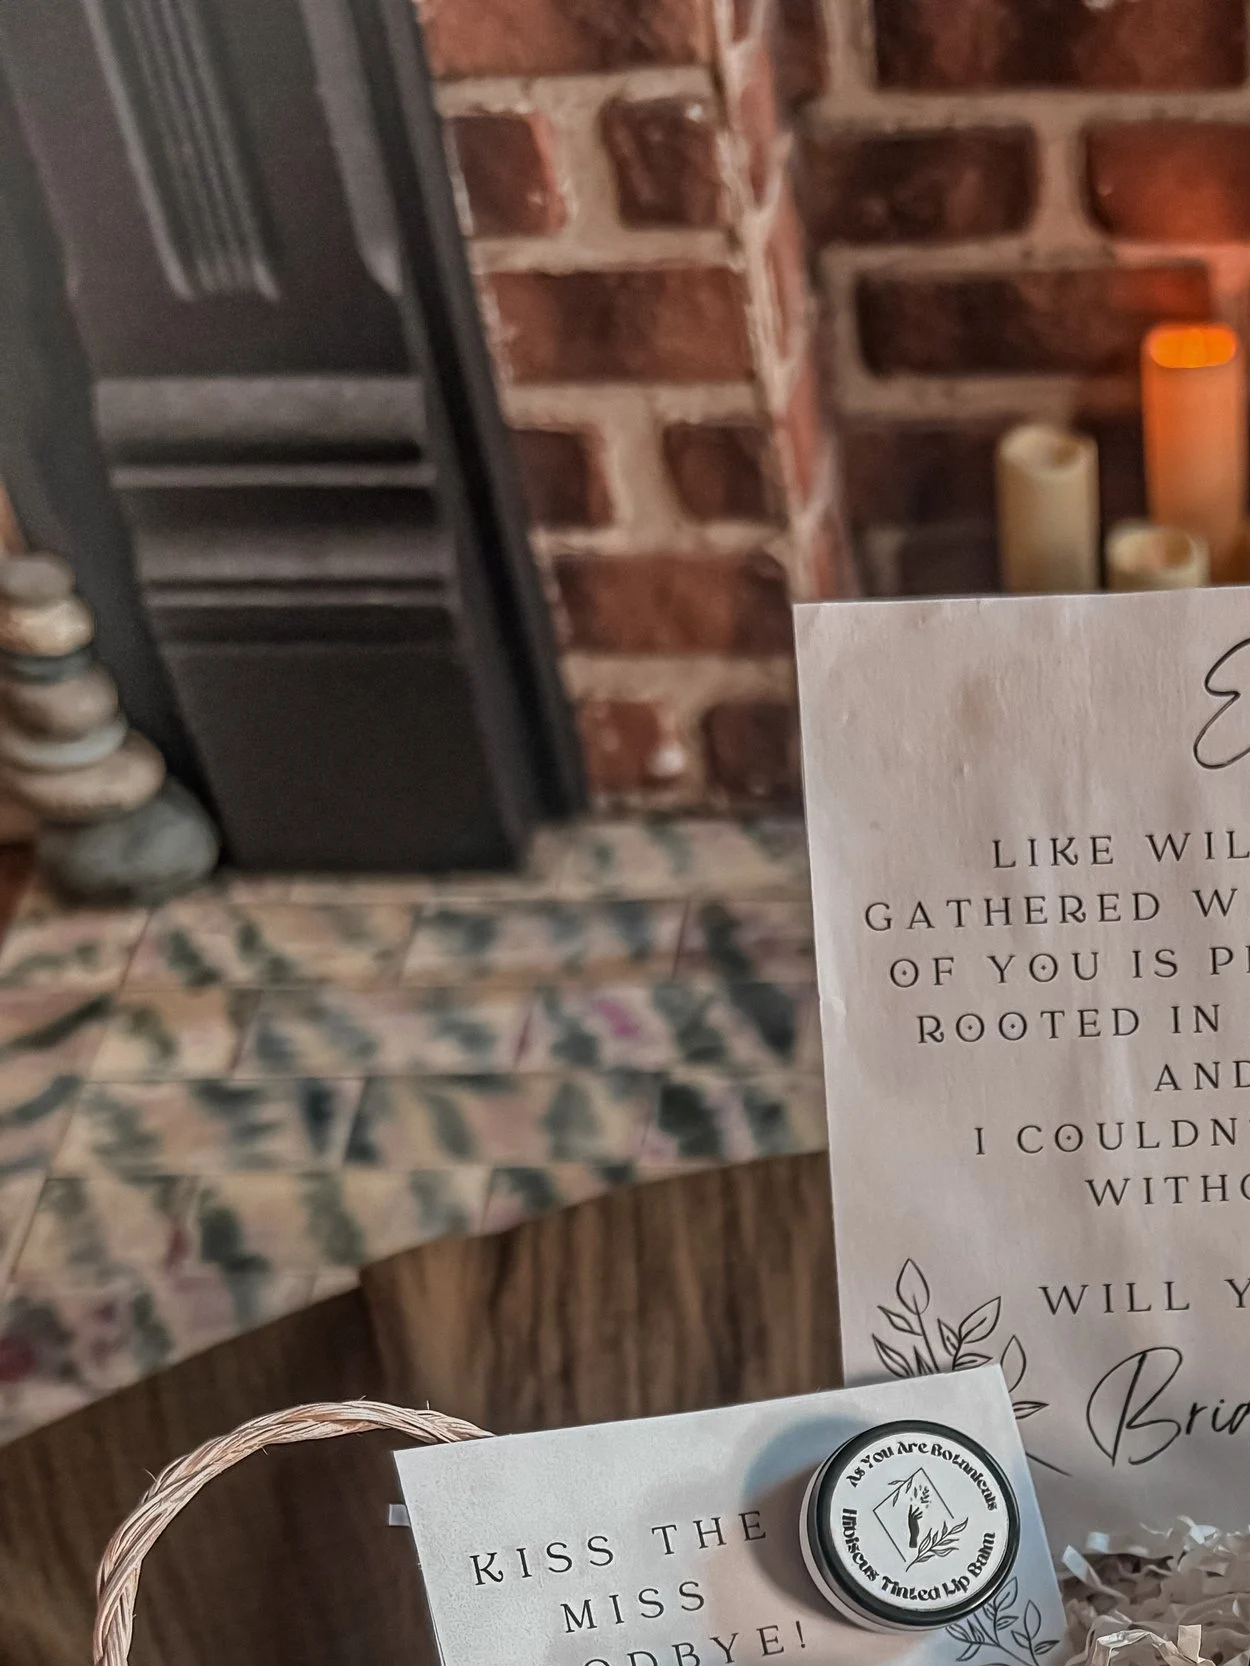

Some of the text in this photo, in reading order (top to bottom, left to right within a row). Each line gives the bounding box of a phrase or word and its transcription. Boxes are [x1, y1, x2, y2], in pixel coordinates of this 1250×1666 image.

[992, 835, 1113, 868] LIKE
[865, 892, 1160, 931] GATHERED
[890, 957, 954, 988] OF
[987, 952, 1098, 983] YOU
[1132, 949, 1177, 978] IS
[917, 1008, 1139, 1043] ROOTED
[1171, 1004, 1220, 1034] IN
[974, 1127, 985, 1155] I
[1038, 1281, 1190, 1315] WILL
[847, 1441, 998, 1511] As You Are Botanicals
[469, 1510, 767, 1585] KISS THE
[842, 1508, 996, 1601] Hibiscus Tinted Lip Balm
[560, 1581, 704, 1633] MISS
